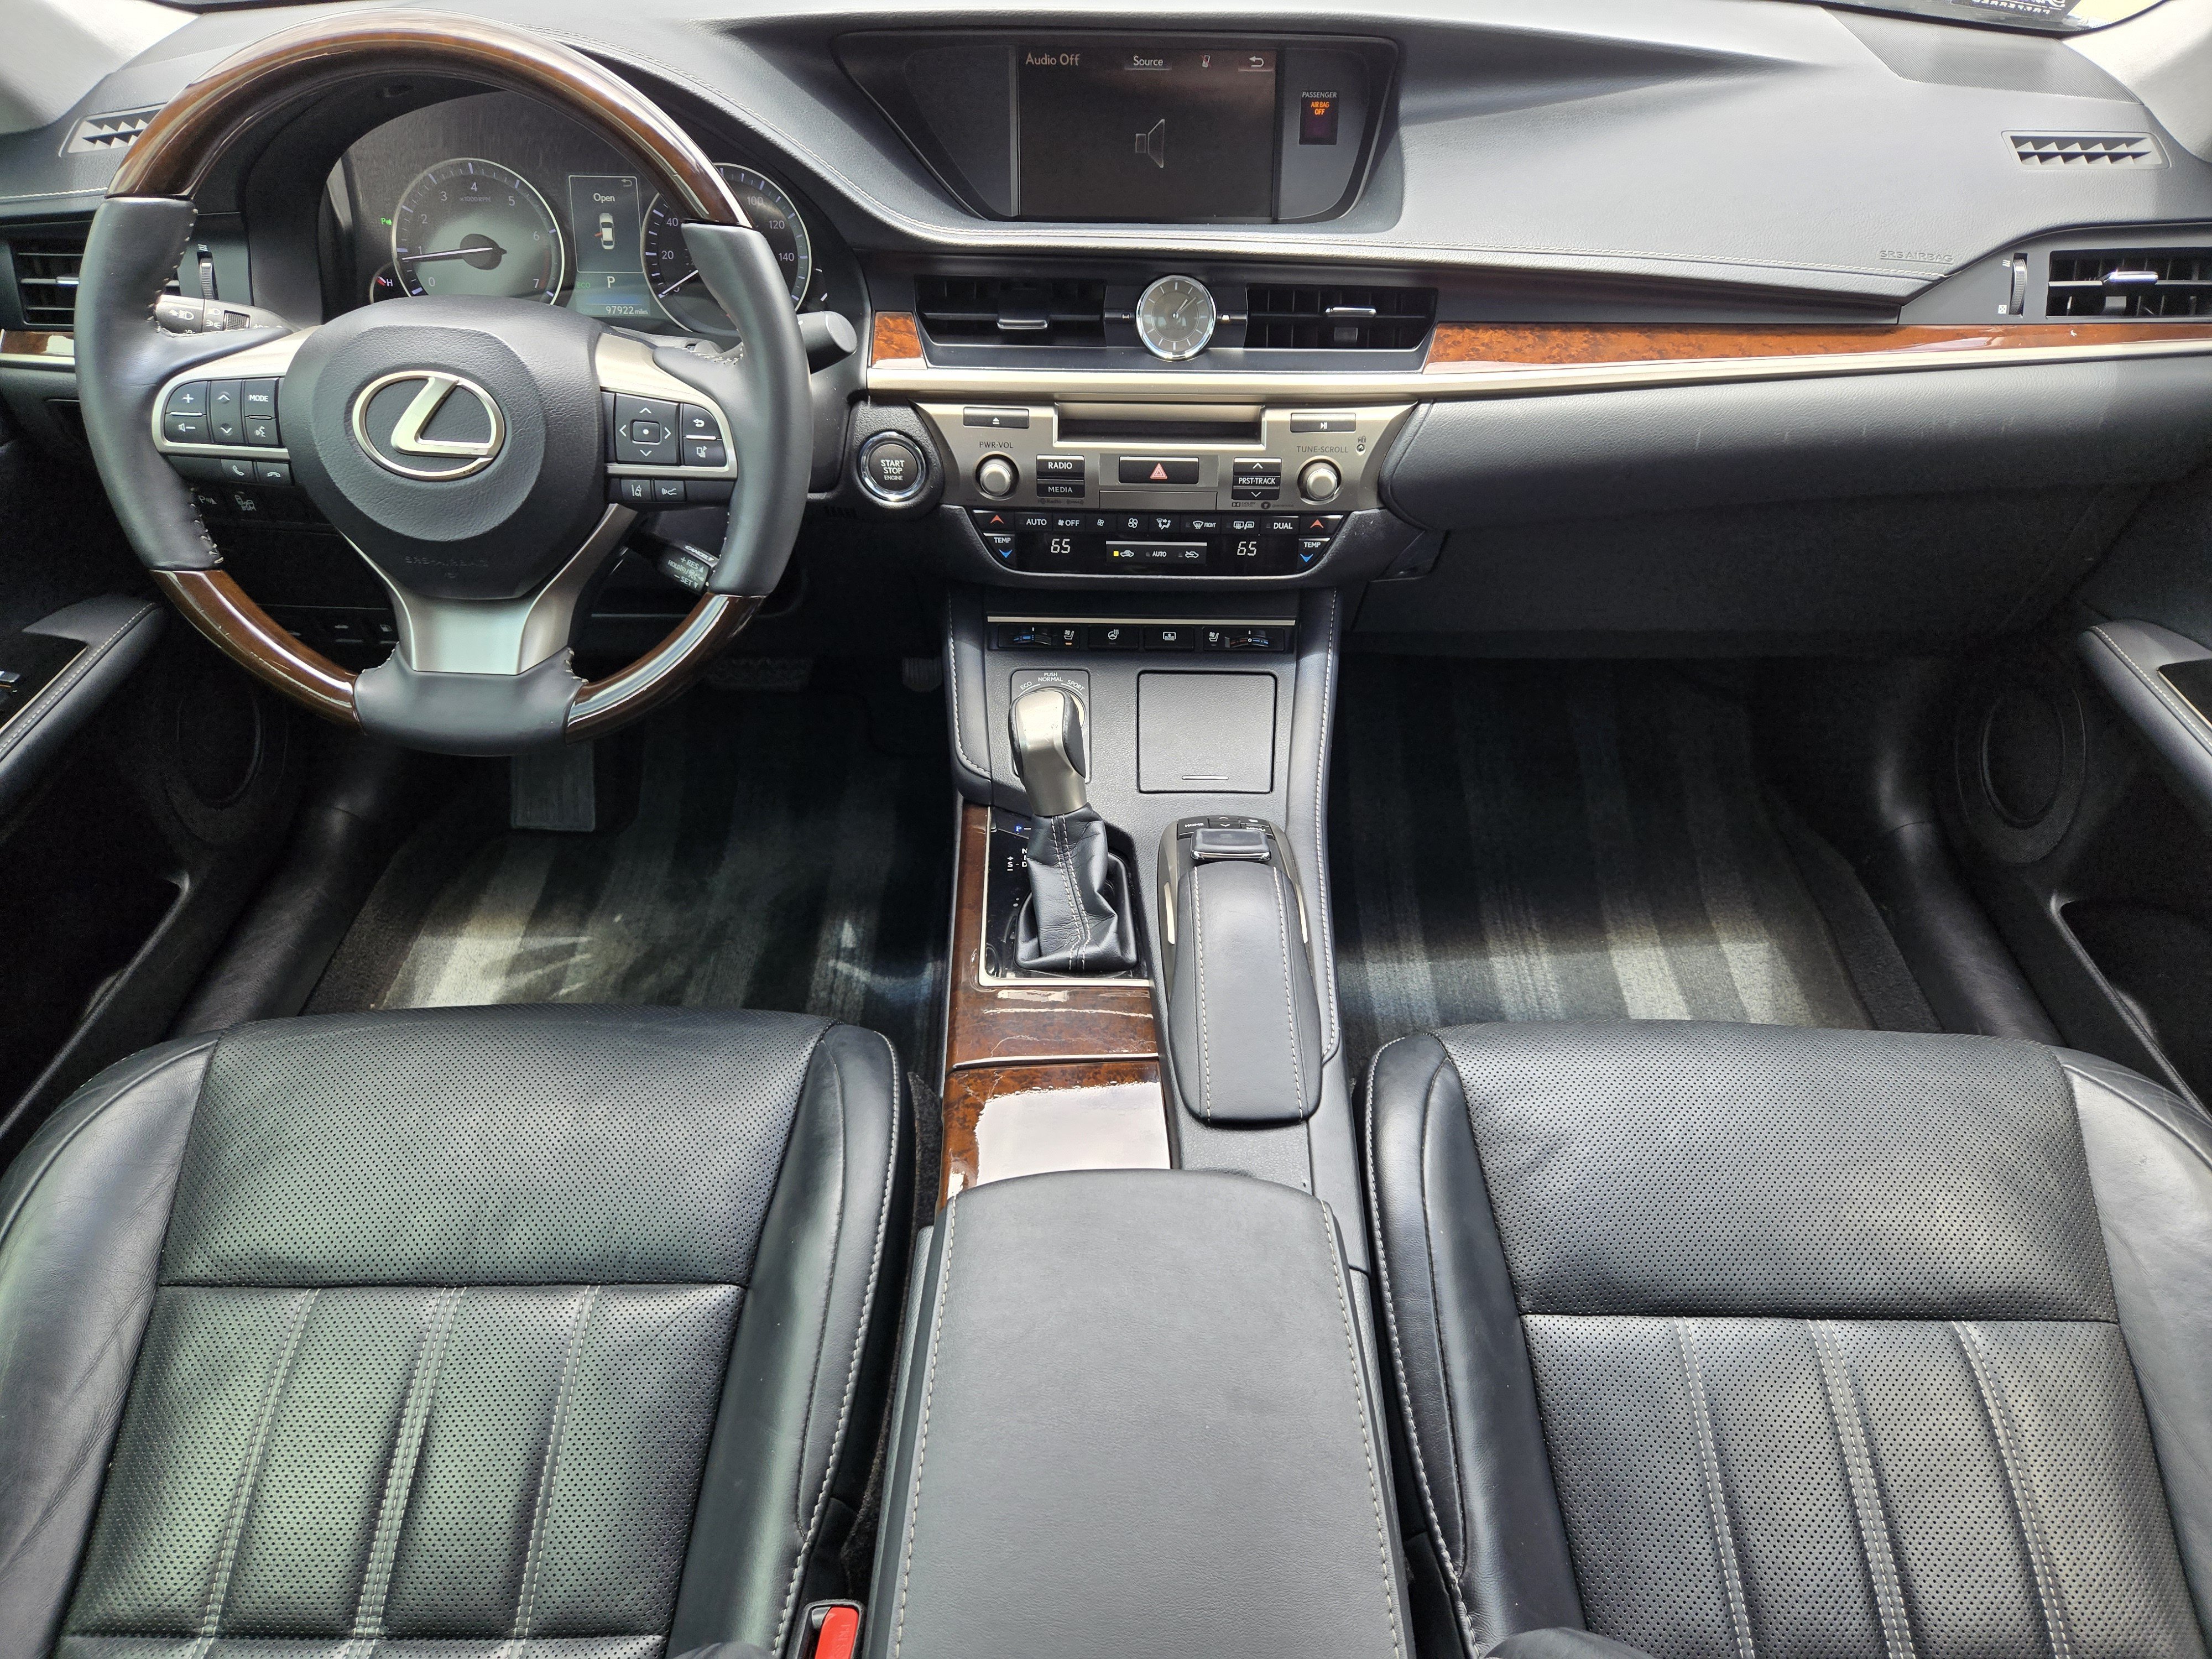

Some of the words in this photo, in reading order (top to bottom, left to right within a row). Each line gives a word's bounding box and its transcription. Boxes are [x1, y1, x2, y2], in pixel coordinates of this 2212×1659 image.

[1025, 53, 1057, 65] Audio
[1060, 54, 1080, 66] Off
[1133, 55, 1164, 66] Source
[471, 182, 478, 192] 4
[441, 191, 447, 201] 3
[508, 196, 515, 206] 5
[593, 192, 615, 203] Open
[747, 196, 764, 206] 100
[421, 214, 428, 224] 2
[666, 217, 679, 227] 40
[769, 220, 785, 229] 120
[533, 231, 540, 240] 6
[661, 251, 674, 260] 20
[778, 253, 795, 262] 140
[1880, 250, 1903, 259] SRS
[1906, 251, 1953, 263] AIRBAG
[429, 277, 435, 286] 0
[533, 279, 540, 289] 7
[607, 276, 615, 288] P
[606, 306, 634, 315] 97922
[249, 393, 269, 403] MODE
[1051, 539, 1071, 554] 65
[1237, 541, 1257, 556] 65
[1020, 681, 1032, 690] ECO
[1067, 680, 1085, 691] SPORT
